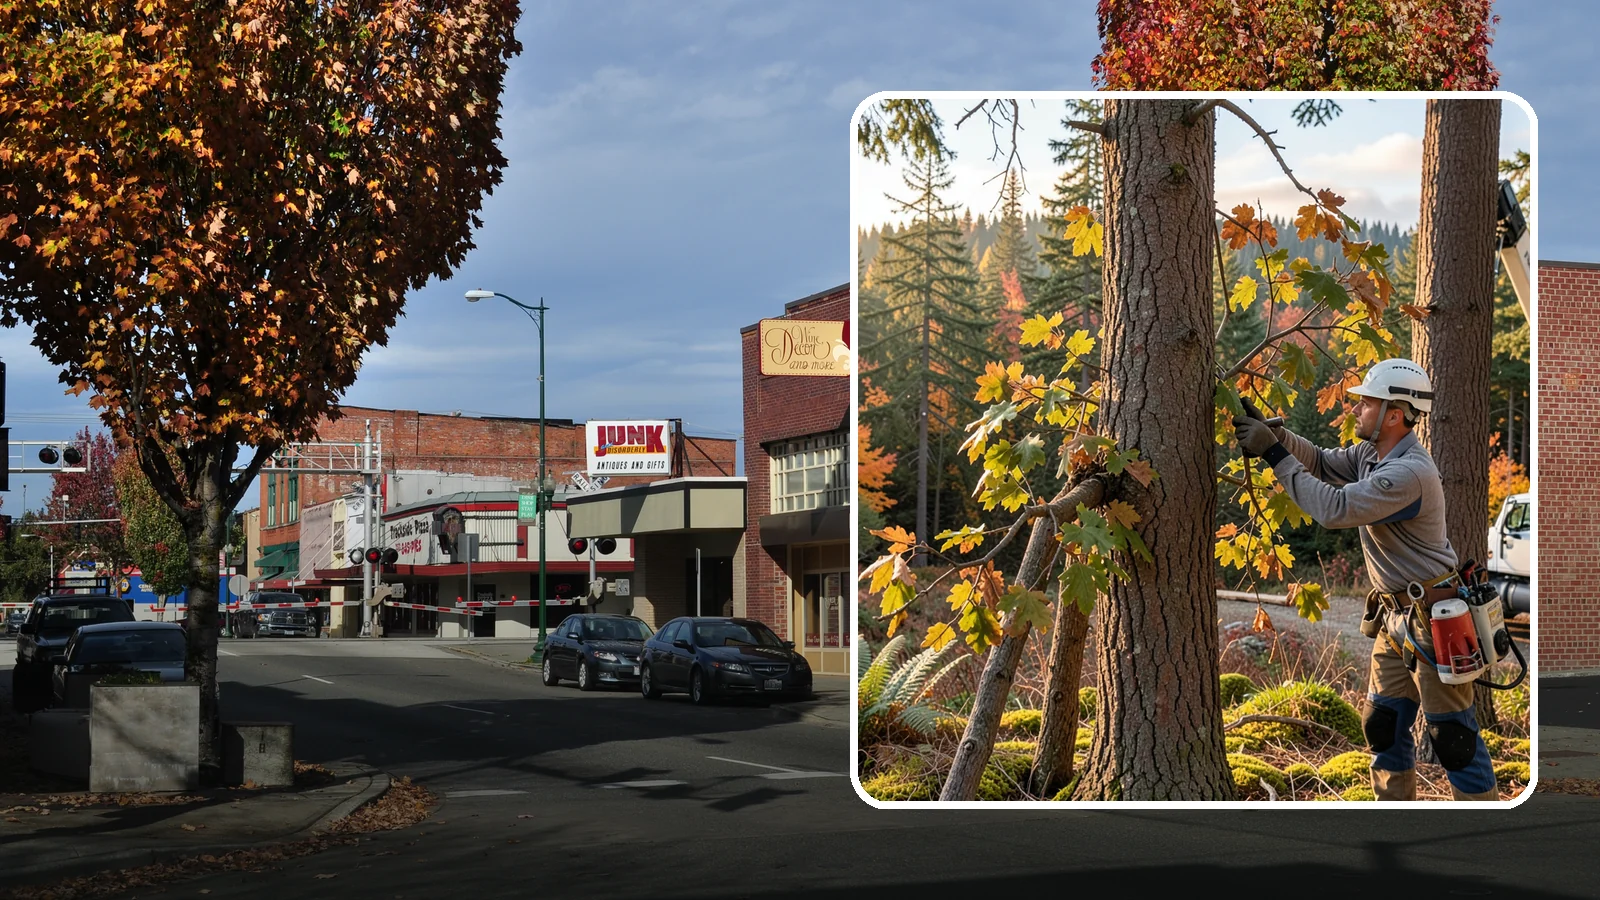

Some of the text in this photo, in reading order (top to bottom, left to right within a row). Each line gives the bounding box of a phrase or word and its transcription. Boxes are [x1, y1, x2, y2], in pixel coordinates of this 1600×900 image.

[595, 425, 665, 457] JUNK
[607, 446, 646, 454] DISORDERLY
[596, 460, 665, 470] ANTIQUES AND GIFTS
[390, 519, 429, 540] Trackside Pizza
